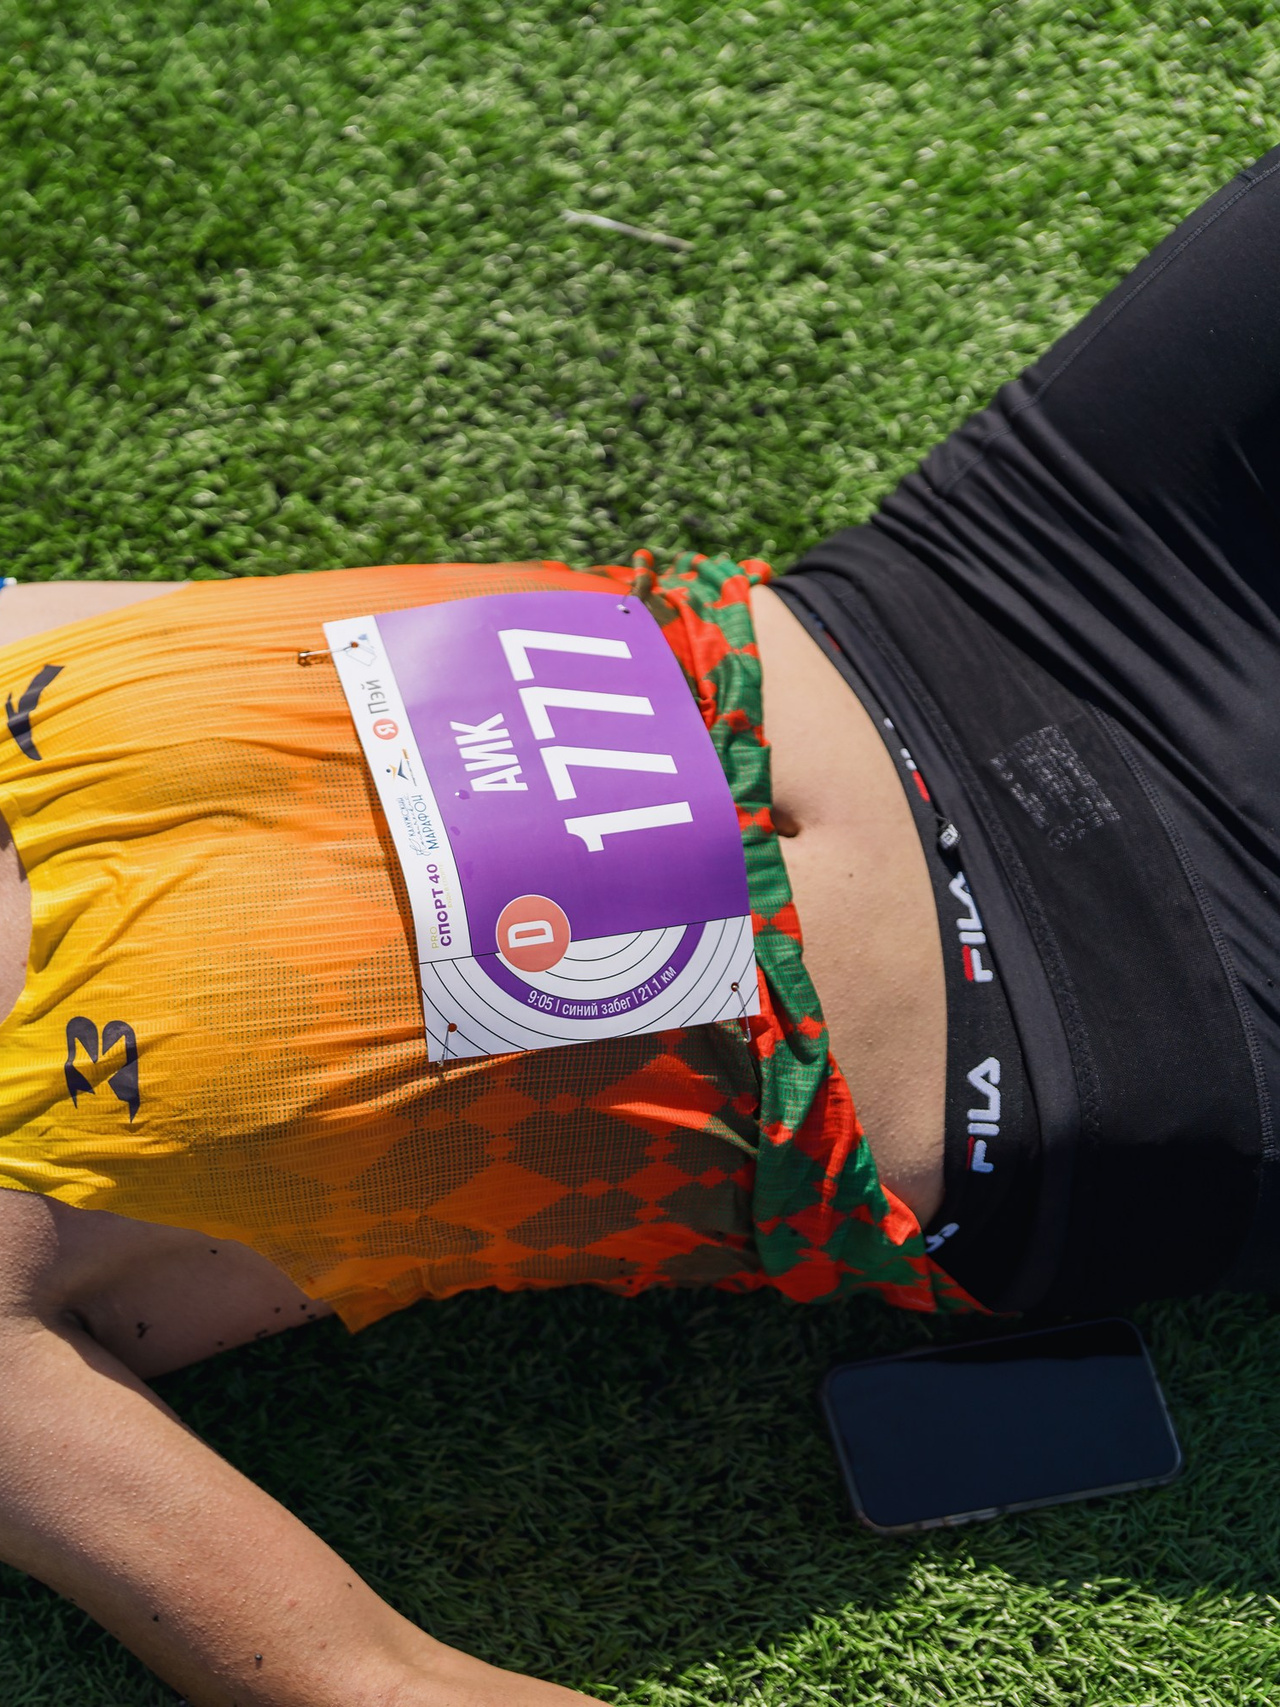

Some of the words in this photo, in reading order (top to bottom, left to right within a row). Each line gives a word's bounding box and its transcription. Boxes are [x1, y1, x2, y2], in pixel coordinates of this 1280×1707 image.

[360, 679, 390, 715] Пэй
[449, 712, 529, 792] АИК
[497, 628, 694, 853] 1777
[411, 794, 440, 851] МАРАФОН
[426, 863, 441, 884] 40
[429, 926, 440, 950] PRO
[431, 888, 453, 947] СПОРТ
[507, 919, 555, 949] D
[526, 990, 554, 1011] 9:05
[562, 1002, 599, 1017] синий
[601, 994, 632, 1015] забег
[637, 979, 663, 1001] 21,1
[663, 965, 678, 984] км
[966, 1056, 1001, 1174] FILA
